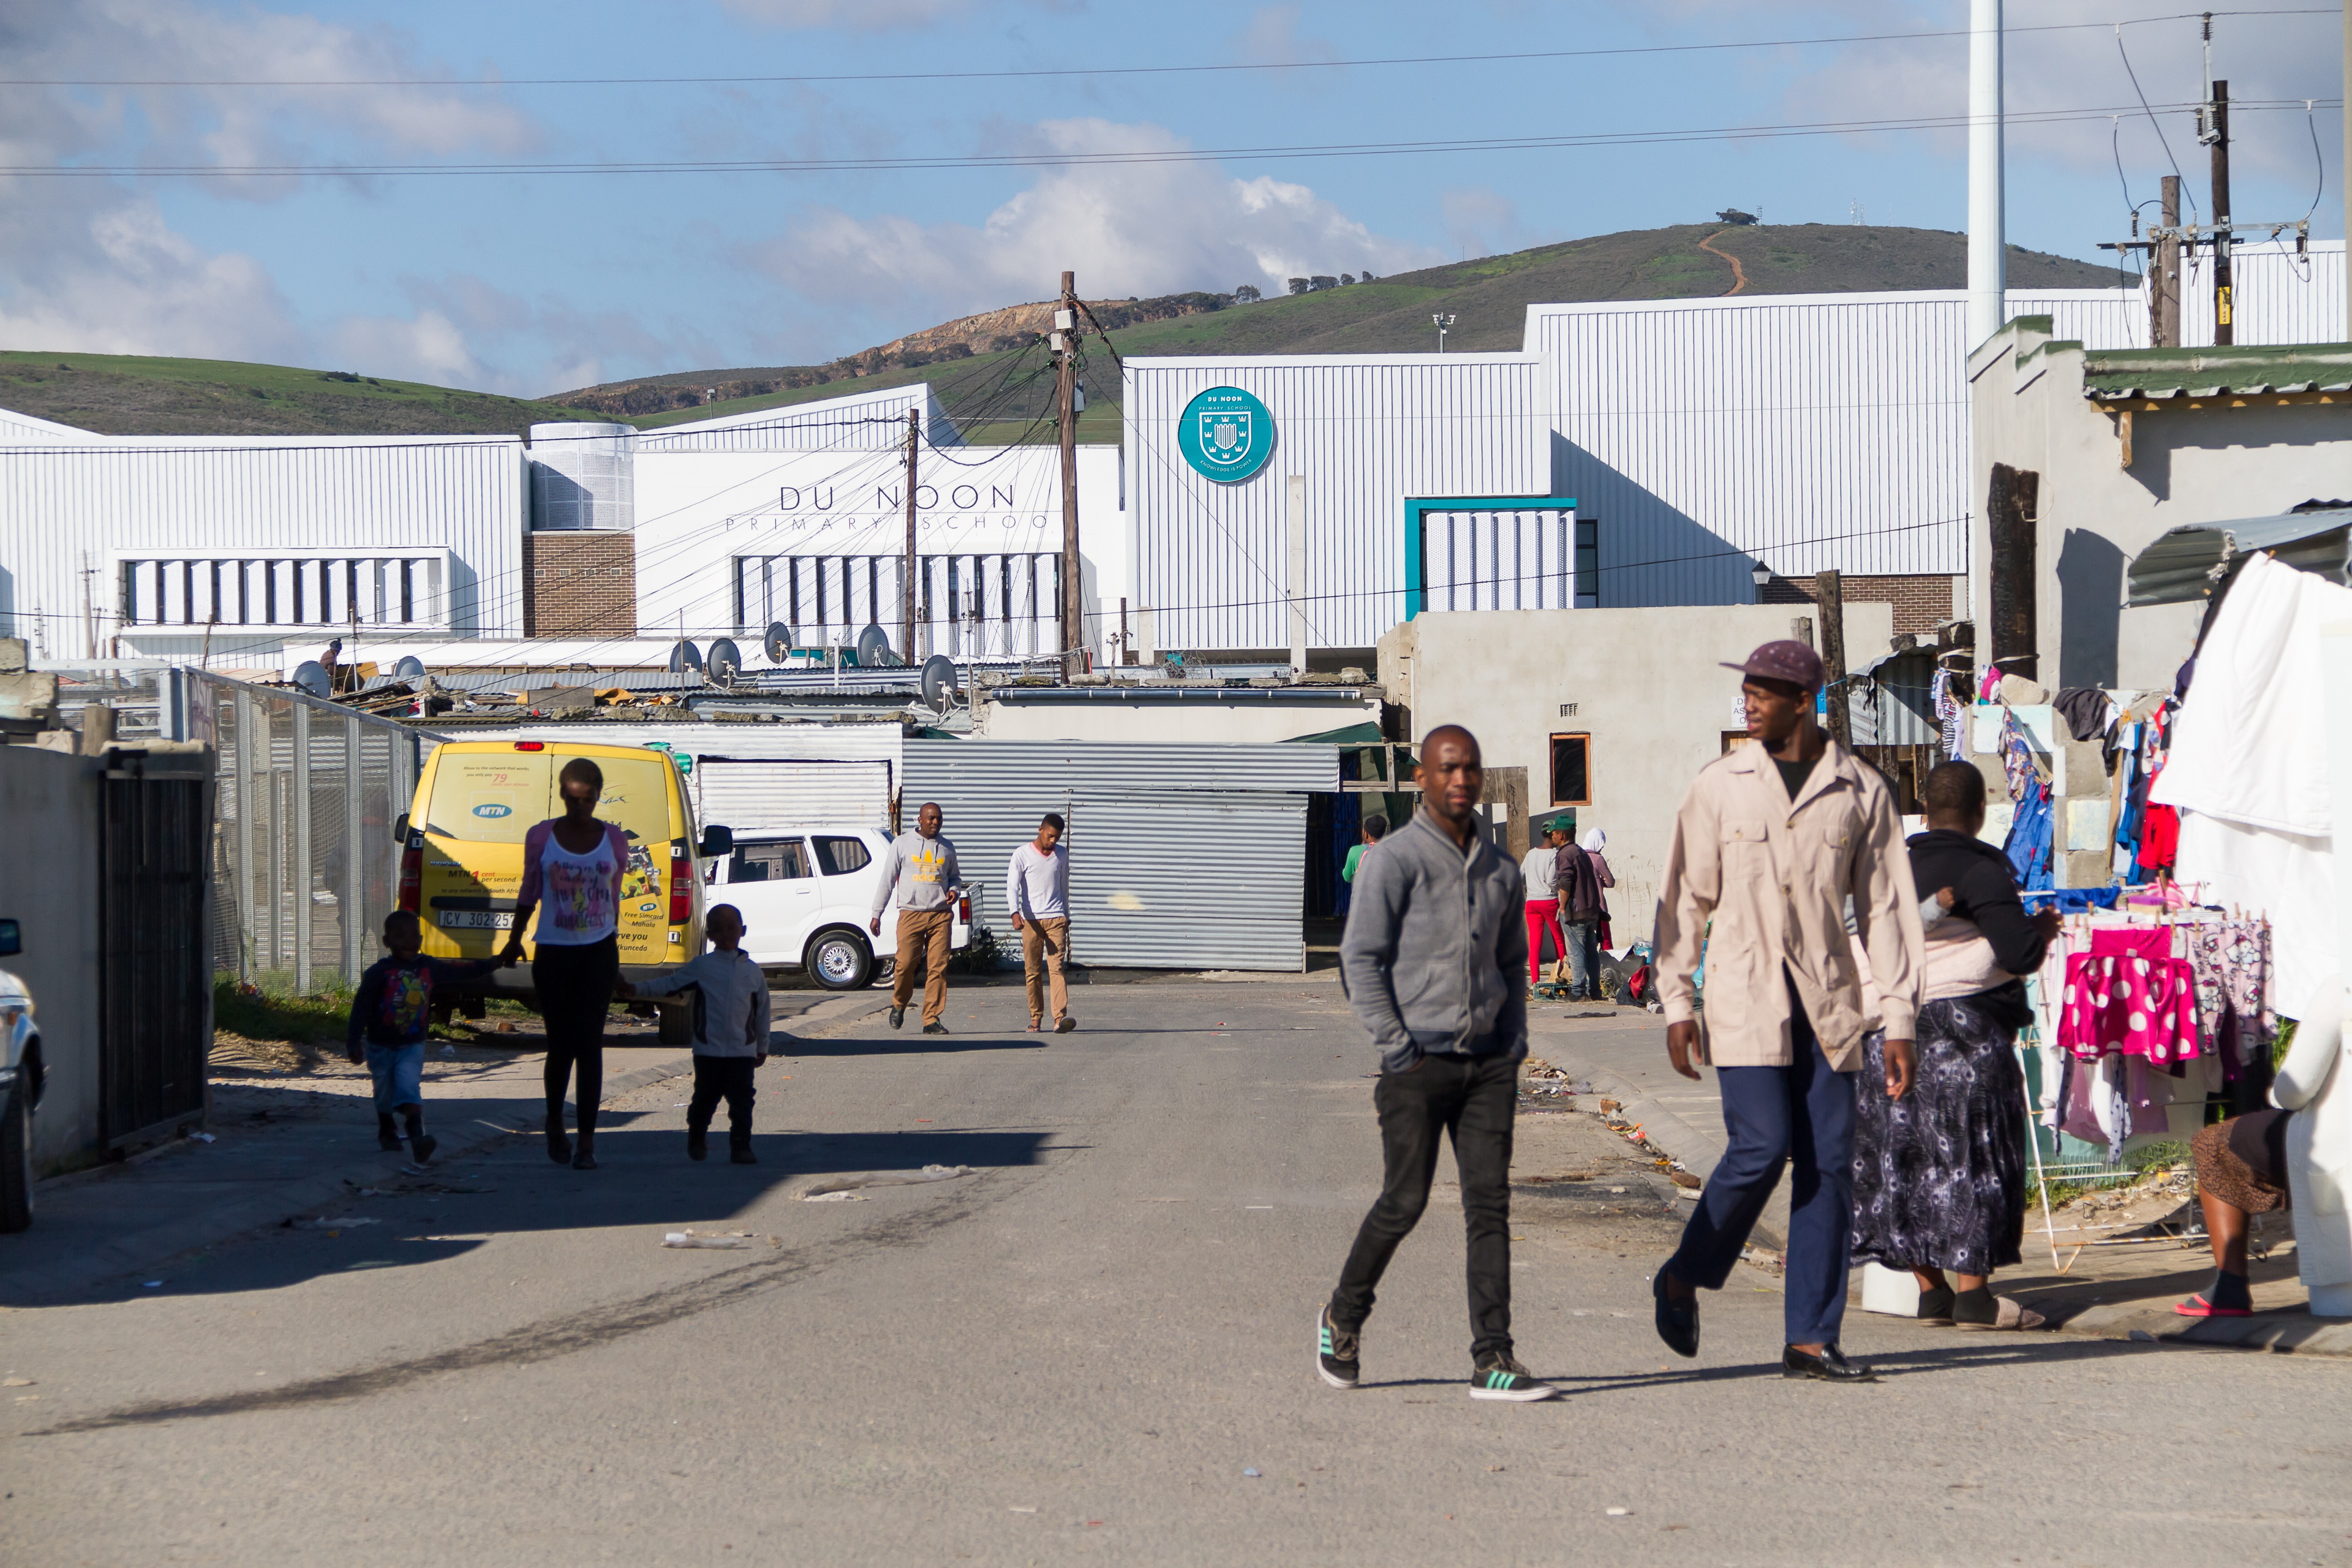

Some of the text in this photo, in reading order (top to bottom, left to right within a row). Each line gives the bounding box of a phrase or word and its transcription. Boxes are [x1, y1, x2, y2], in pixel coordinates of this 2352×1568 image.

[1200, 460, 1230, 472] KNOWLEDGE
[1236, 458, 1252, 469] POWER
[780, 485, 1013, 510] DU NOON
[726, 515, 1047, 531] PRIMARY SCHOO
[493, 774, 507, 783] 79
[479, 807, 506, 816] MTN
[470, 871, 480, 886] 1
[446, 912, 461, 926] CY
[632, 934, 648, 942] you
